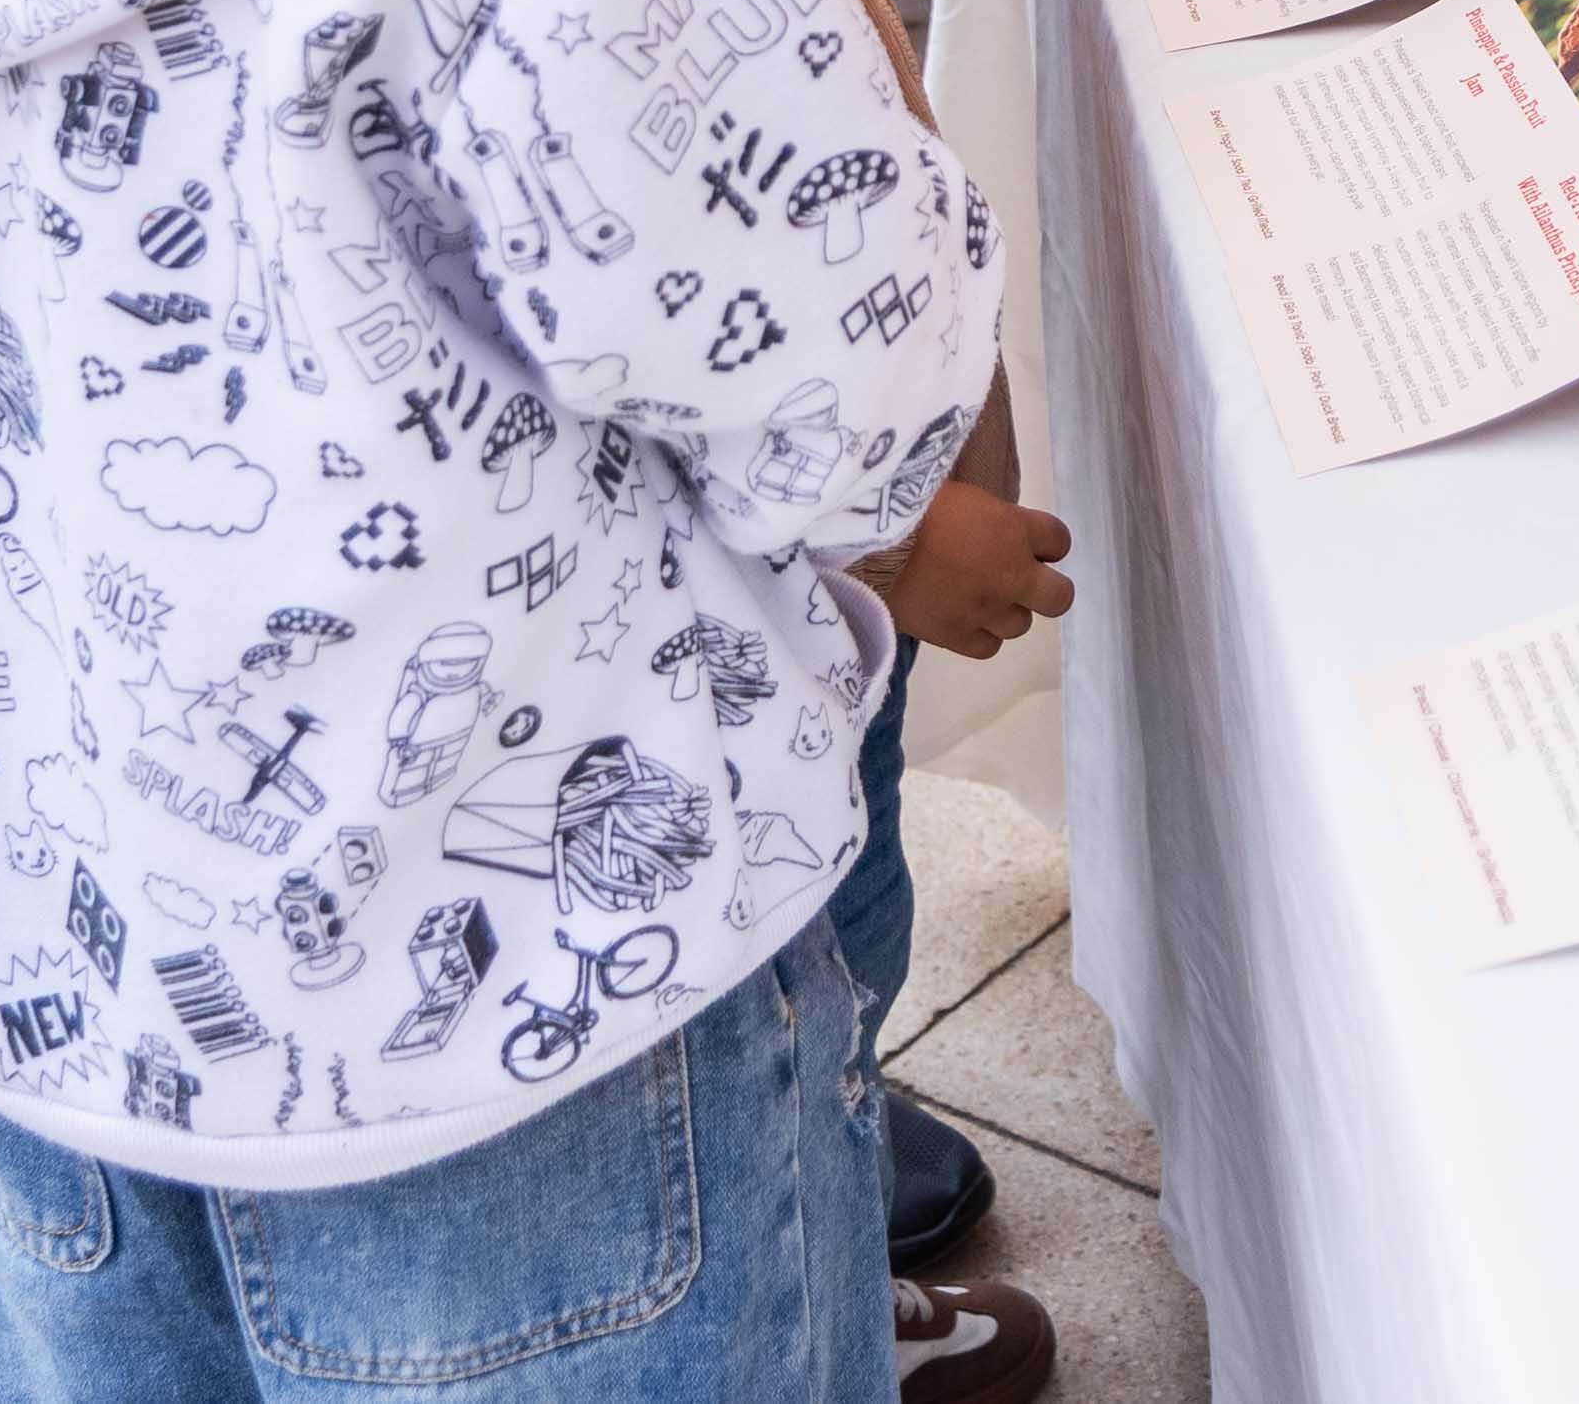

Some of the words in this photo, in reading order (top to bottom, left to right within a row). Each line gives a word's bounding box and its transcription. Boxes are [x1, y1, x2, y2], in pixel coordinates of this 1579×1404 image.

[1465, 7, 1501, 56] Pineapple
[1493, 54, 1509, 66] &
[1498, 62, 1528, 103] Passion
[1459, 73, 1484, 97] Jam
[1520, 99, 1546, 129] Fruit
[1517, 175, 1542, 205] With
[1530, 202, 1567, 255] Ailanthus
[95, 571, 149, 627] OLD
[123, 749, 305, 858] SPLASH!
